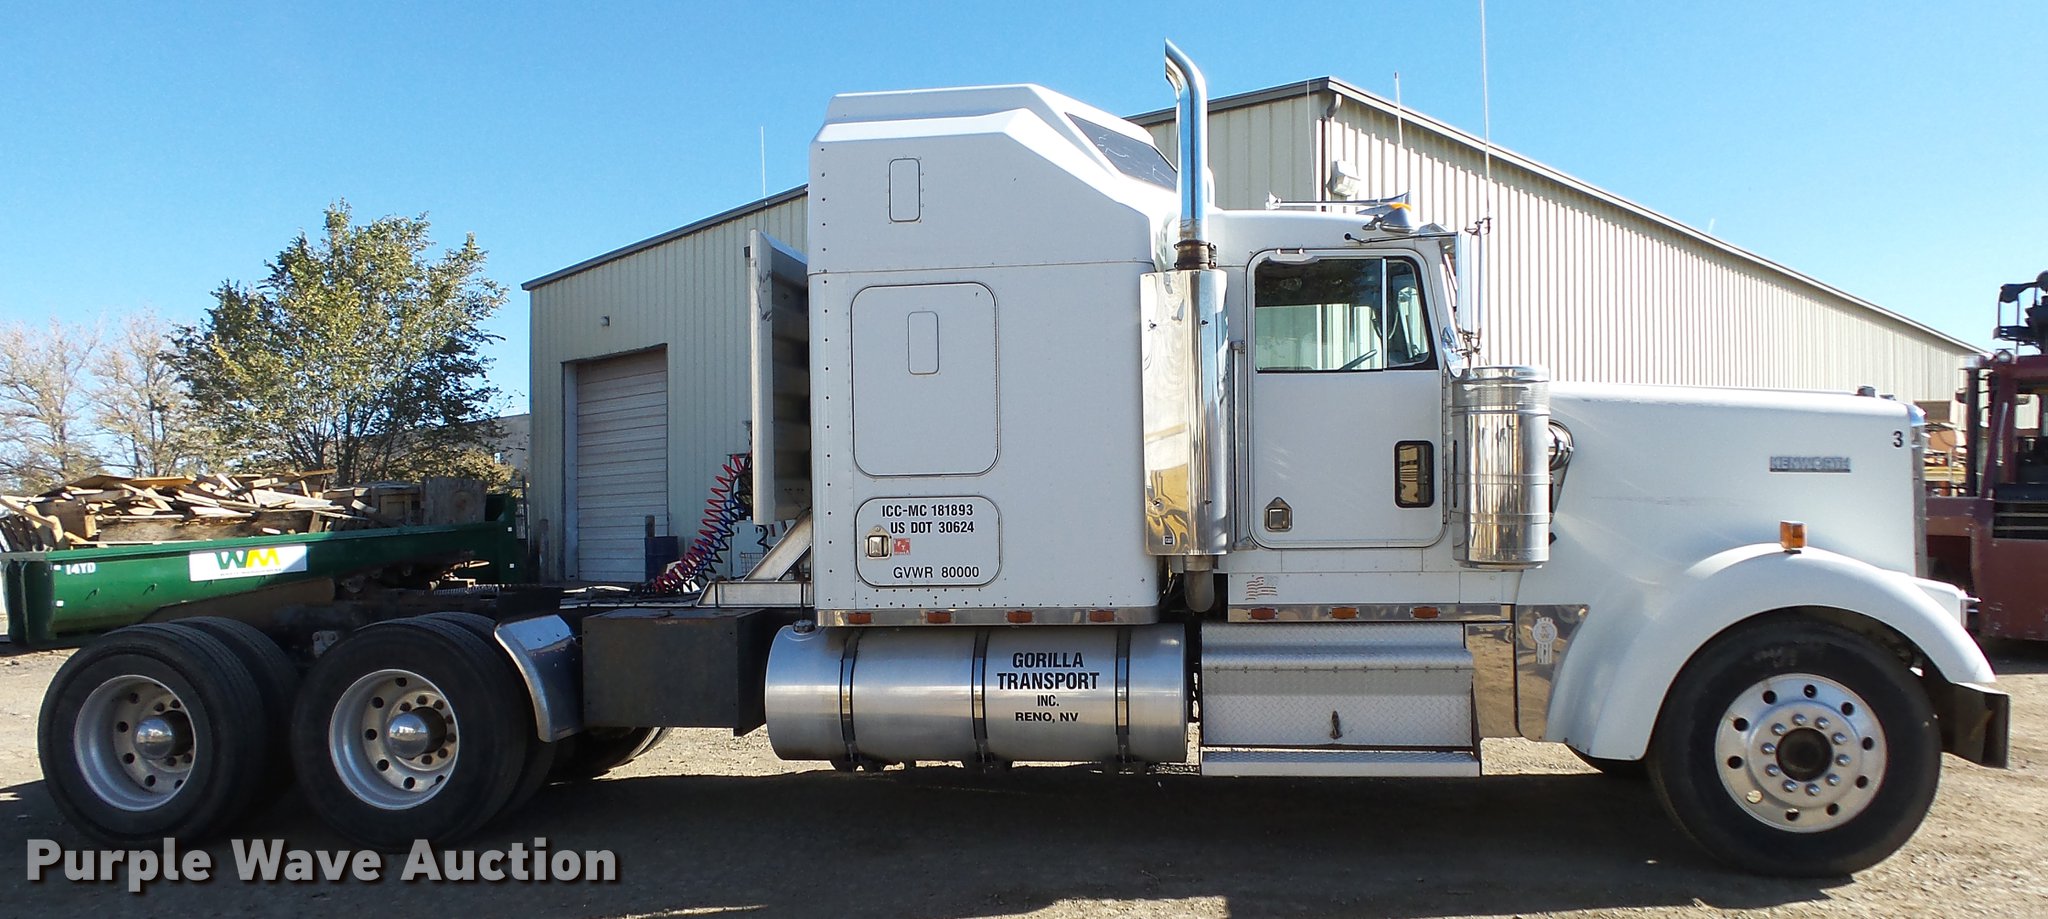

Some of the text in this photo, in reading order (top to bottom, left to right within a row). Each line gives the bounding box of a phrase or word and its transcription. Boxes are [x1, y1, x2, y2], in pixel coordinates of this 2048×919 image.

[1893, 431, 1904, 448] 3
[1770, 456, 1851, 470] KENWORTH
[882, 504, 973, 517] ICC-MC 181893
[890, 521, 974, 533] US DOT 30624
[893, 566, 979, 578] GVWR 80000
[1012, 652, 1084, 668] GORILLA
[997, 672, 1099, 690] TRANSPORT
[1037, 695, 1060, 707] INC.
[1015, 712, 1079, 723] RENO, NV
